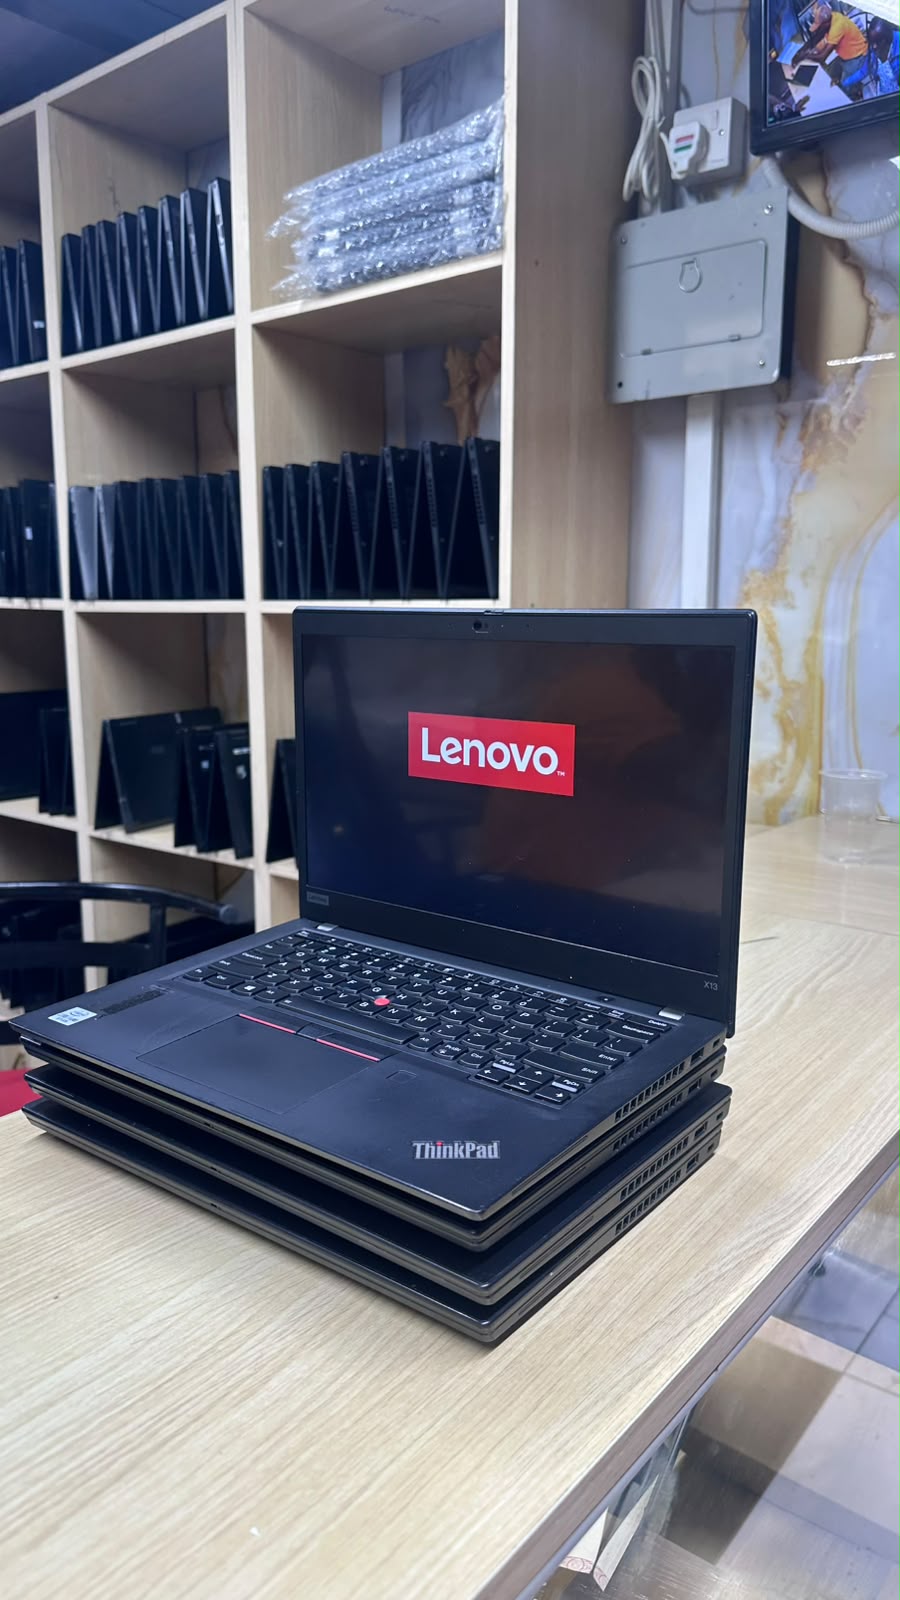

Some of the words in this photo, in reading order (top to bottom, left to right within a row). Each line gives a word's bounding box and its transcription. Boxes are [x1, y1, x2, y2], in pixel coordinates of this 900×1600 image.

[421, 727, 559, 776] Lenovo
[703, 980, 718, 991] X13
[599, 1053, 617, 1062] Enter
[412, 1140, 500, 1160] ThinkPad
